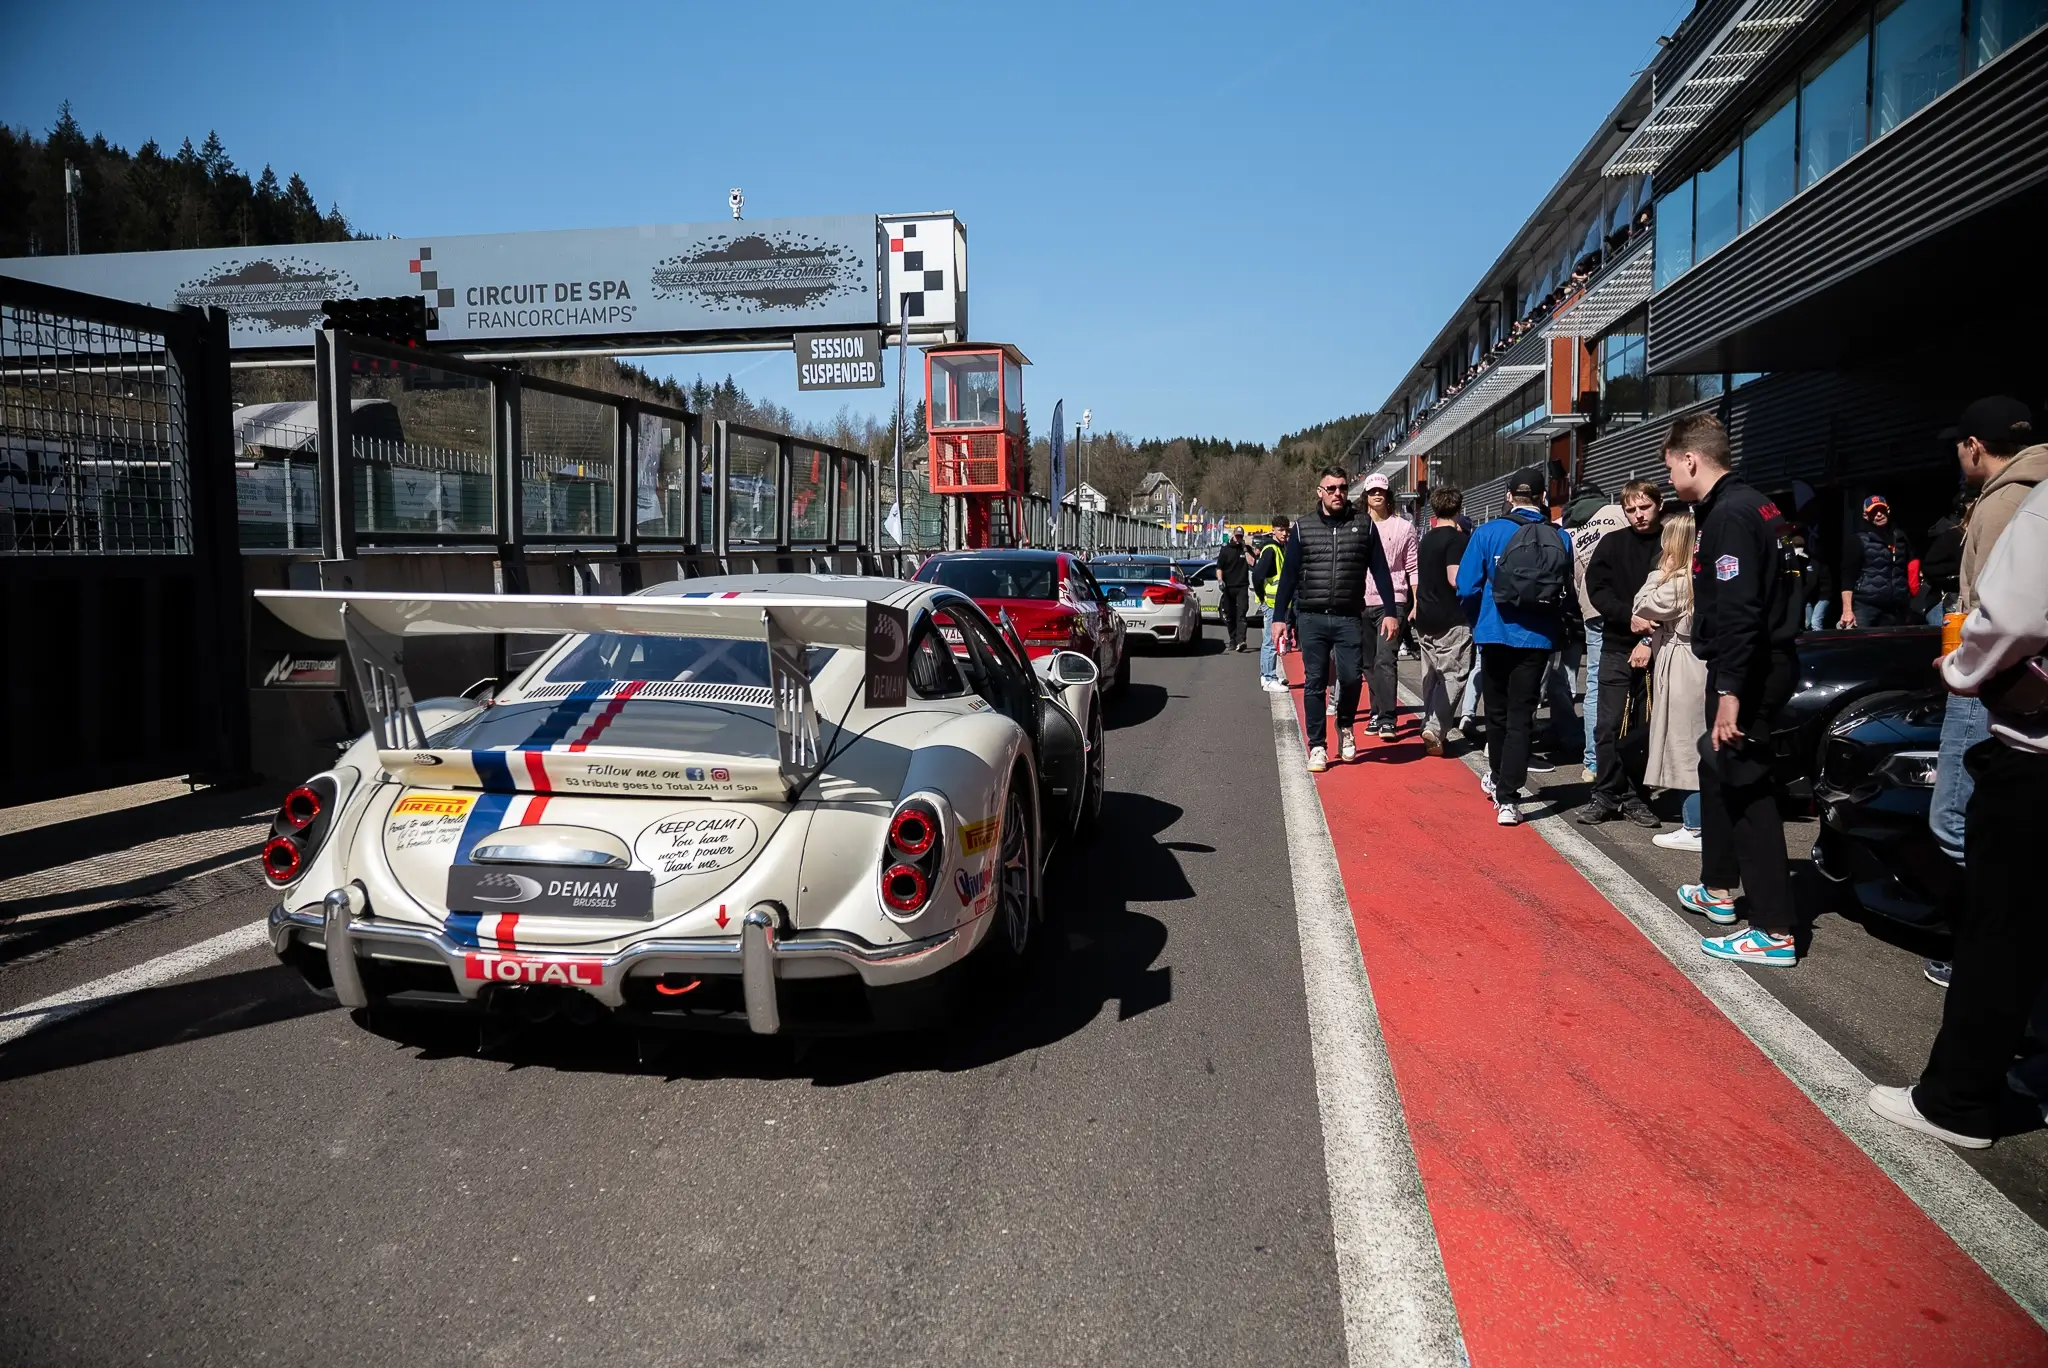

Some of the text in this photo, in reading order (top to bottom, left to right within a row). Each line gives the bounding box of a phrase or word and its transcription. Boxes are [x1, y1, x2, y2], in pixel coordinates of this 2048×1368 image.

[672, 266, 838, 284] LES BRULEURS DE GOMMES
[272, 292, 287, 302] DE
[289, 290, 338, 301] GOMMES
[466, 280, 631, 306] CIRCUIT DE SPA
[811, 337, 864, 359] SESSION
[802, 361, 876, 384] SUSPENDED
[1576, 519, 1602, 533] MOTOR
[1602, 518, 1616, 526] CO.
[1575, 528, 1601, 552] Ford
[1126, 620, 1147, 628] GT4
[294, 660, 337, 671] ASSETTO CORSA
[873, 675, 904, 698] DEMAN
[586, 763, 681, 779] Follow me on
[565, 777, 759, 792] 53 tribute goes to Total 24H of Spa
[395, 797, 468, 813] PIRELLI
[654, 820, 696, 835] KEEP
[671, 832, 729, 848] You have
[657, 845, 735, 862] more power
[663, 859, 721, 873] than me.
[547, 880, 619, 898] DEMAN
[572, 898, 617, 908] BRUSSELS
[475, 953, 592, 984] TOTAL
